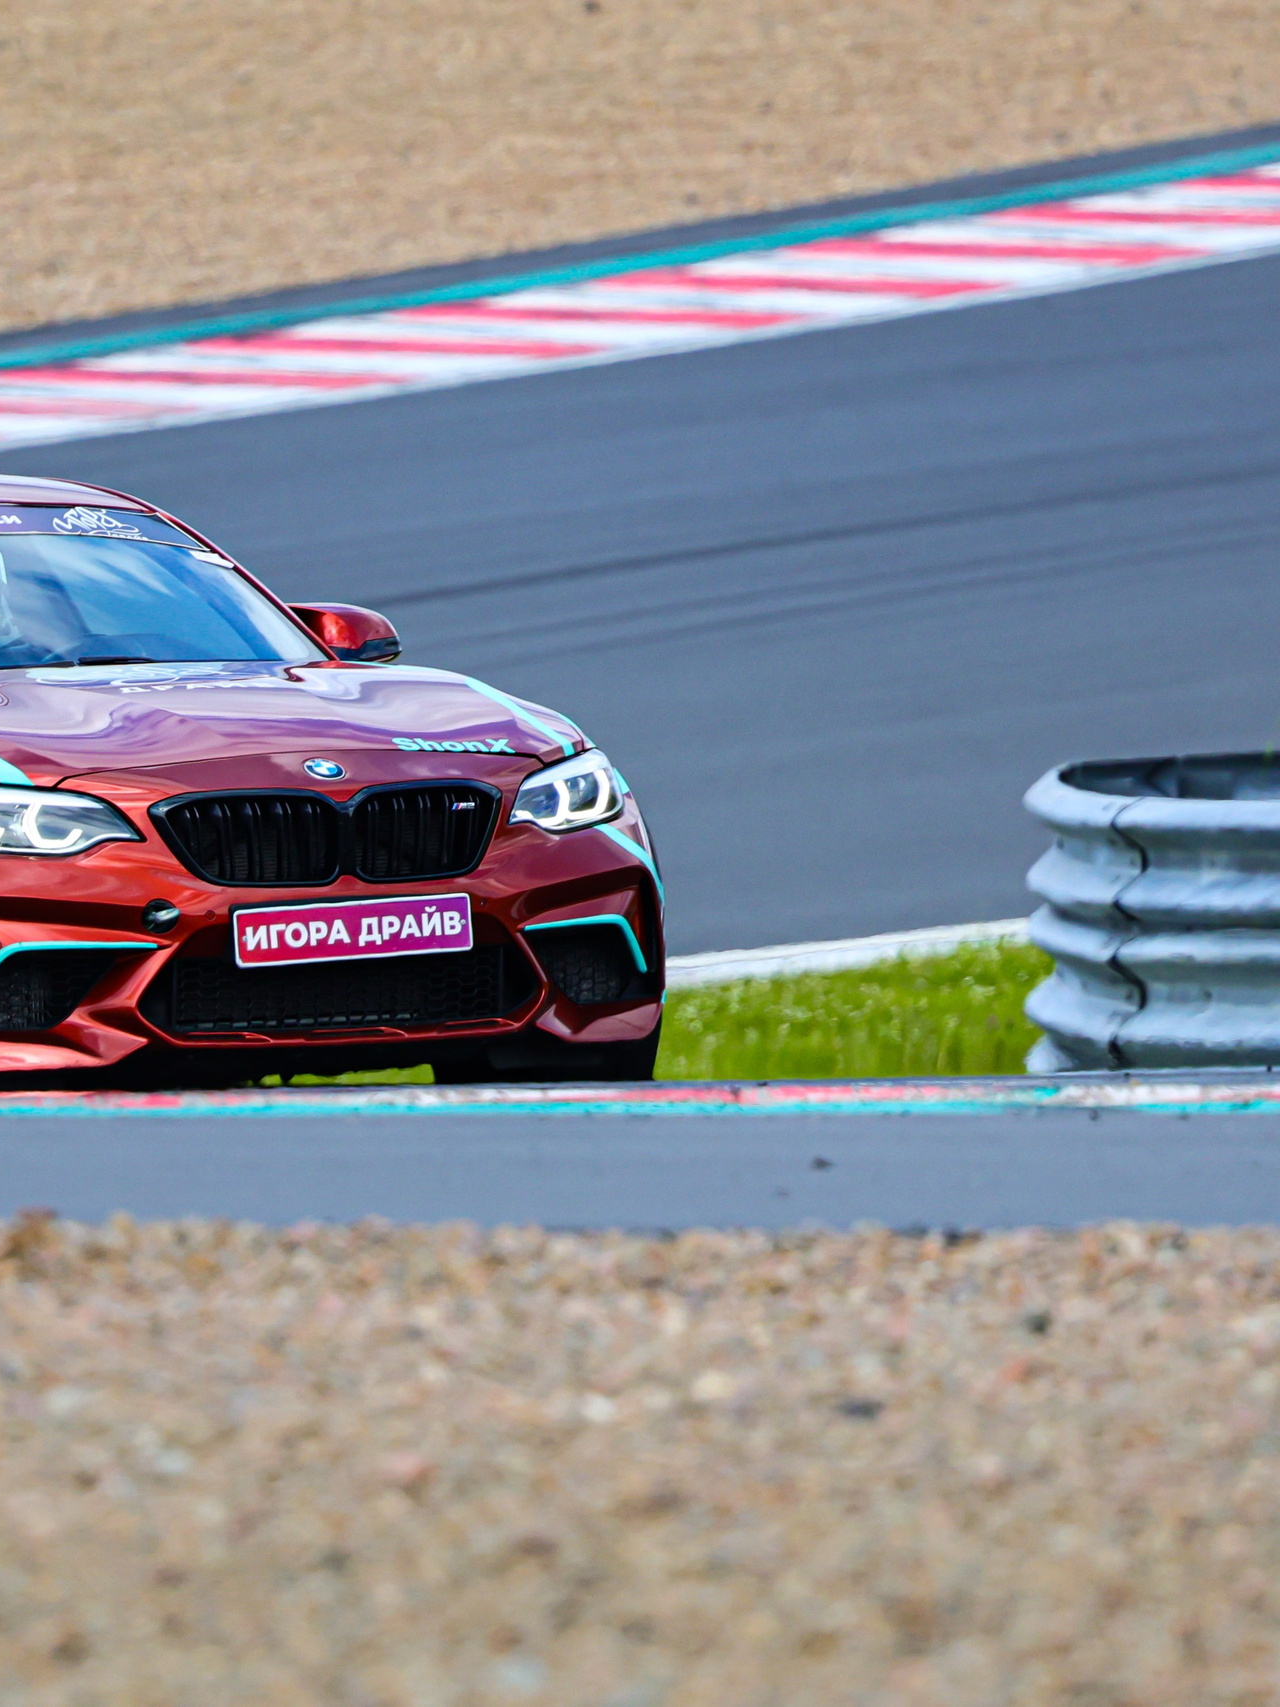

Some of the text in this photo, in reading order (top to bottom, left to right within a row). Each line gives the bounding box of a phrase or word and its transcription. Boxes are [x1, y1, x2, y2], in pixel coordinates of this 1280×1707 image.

[391, 737, 516, 754] ShonX
[245, 906, 462, 951] ИГОРА ДРАЙВ
